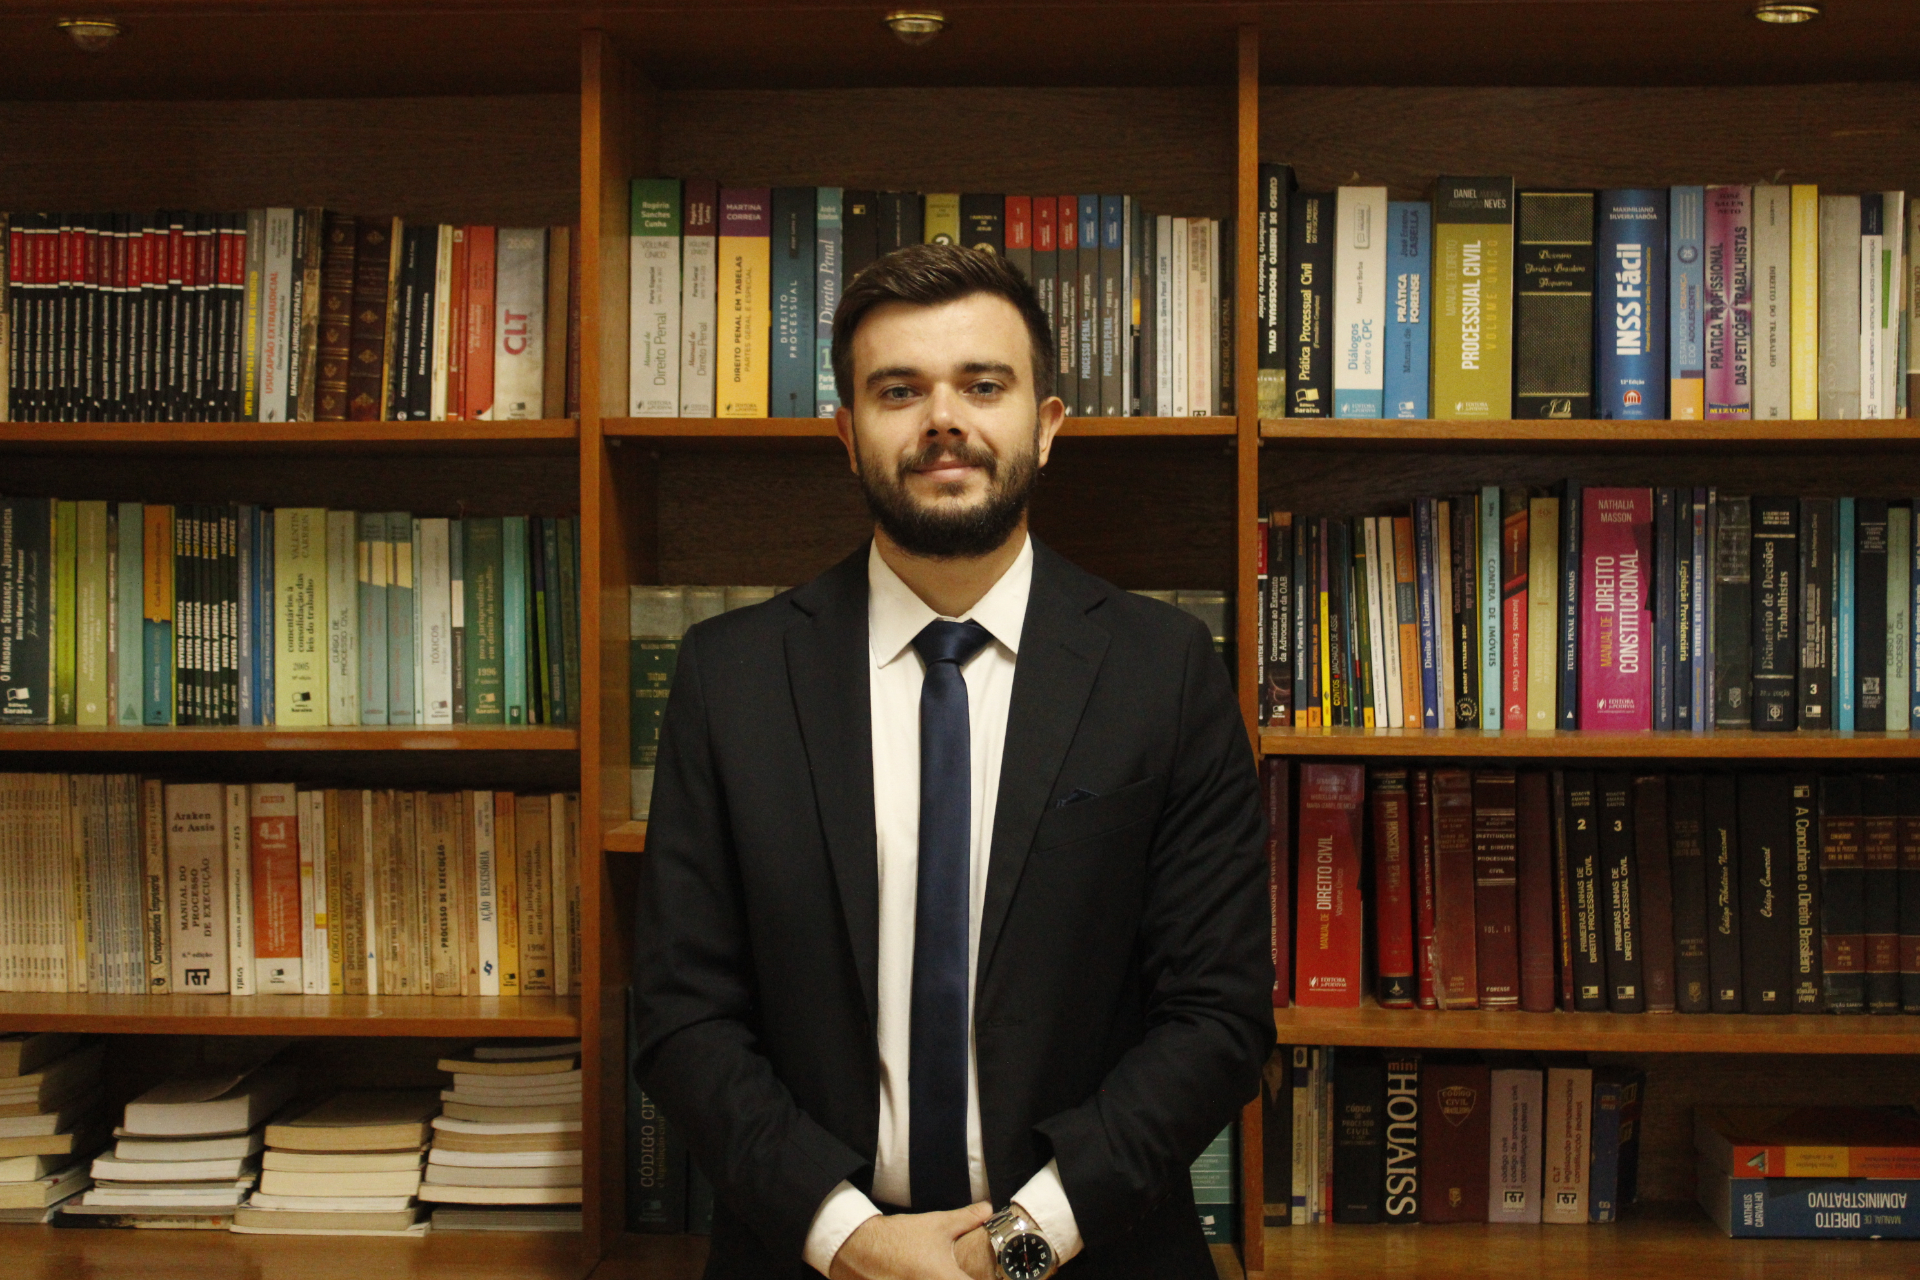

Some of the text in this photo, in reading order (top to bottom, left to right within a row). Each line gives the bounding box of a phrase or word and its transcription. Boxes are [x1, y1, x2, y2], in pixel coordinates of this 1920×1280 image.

[1270, 177, 1278, 208] CURSO
[1453, 189, 1476, 198] DANIEL
[1484, 200, 1506, 208] NEVES
[1270, 212, 1278, 224] DE
[1410, 210, 1419, 257] CASELLA
[735, 298, 742, 311] EM
[819, 240, 835, 325] Direito Penal
[1269, 268, 1277, 326] PROCESSUAL
[1395, 274, 1407, 322] PRÁTICA
[1410, 274, 1420, 323] FORENSE
[1462, 240, 1481, 370] PROCESSUAL CIVIL
[1484, 240, 1498, 350] VOLUME ÚNICO
[1615, 244, 1641, 355] INSS Fácil
[780, 294, 788, 343] DIREITO
[1299, 263, 1313, 380] Prática Processual Civil
[1680, 311, 1687, 323] DA
[1708, 243, 1723, 369] PRÁTICA PROFISSIONAL
[1732, 227, 1749, 385] DAS PETIÇÕES TRABALHISTAS
[264, 272, 278, 394] USUCAPIÃO EXTRAJUDICIAL
[419, 292, 429, 375] Direito Previdenciário
[503, 309, 527, 355] CLT
[644, 332, 650, 342] de
[654, 312, 666, 385] Direito Penal
[1082, 319, 1091, 378] PROCESSO PENAL
[1104, 317, 1112, 376] PROCESSO PENAL
[1268, 330, 1276, 354] CIVIL
[1348, 324, 1359, 370] Diálogos
[1362, 319, 1372, 340] CPC
[1688, 345, 1695, 358] DO
[1363, 350, 1371, 374] sobre
[1598, 500, 1634, 509] NATHALIA
[1600, 513, 1632, 523] MASSON
[1280, 576, 1288, 594] OAB
[1280, 595, 1287, 604] da
[1422, 589, 1430, 626] Literatura
[1762, 542, 1774, 669] Dicionário de Decisões
[1777, 571, 1788, 641] Trabalhistas
[285, 594, 294, 652] comentários
[295, 573, 306, 652] consolidação das
[305, 579, 314, 652] leis do trabalho
[1270, 576, 1278, 662] Comentários ao Estatuto
[1279, 613, 1287, 651] Advocacia
[1330, 615, 1338, 632] ASSIS
[1488, 558, 1498, 667] COMPRA DE IMÓVEIS
[1568, 605, 1574, 615] DE
[1596, 556, 1614, 667] MANUAL DE DIREITO
[1619, 550, 1638, 673] CONSTITUCIONAL
[1680, 560, 1689, 661] Legislação Previdenciária
[1280, 652, 1287, 662] da
[1331, 633, 1338, 641] DE
[1331, 643, 1340, 674] MACHADO
[1424, 640, 1432, 668] Direito
[1577, 819, 1586, 830] 2
[1795, 807, 1808, 816] A
[1317, 835, 1333, 863] CIVIL
[1795, 819, 1810, 871] Concubina
[179, 866, 188, 930] MANUAL DO
[191, 869, 199, 927] PROCESSO
[201, 858, 212, 937] DE EXECUÇÃO
[439, 893, 447, 902] DE
[478, 850, 493, 922] AÇÃO RESCISÓRIA
[1316, 866, 1332, 910] DIREITO
[1718, 828, 1732, 934] Código Tributário Nacional
[1760, 846, 1774, 918] Código Comercial
[440, 906, 448, 948] PROCESSO
[1577, 867, 1587, 952] PRIMEIRAS LINHAS DE
[1585, 856, 1597, 963] DIREITO PROCESSUAL CIVIL
[1797, 893, 1812, 925] Direito
[1320, 924, 1329, 949] MANUAL
[1798, 928, 1814, 973] Brasileiro
[638, 1125, 655, 1187] CÓDIGO
[1385, 1072, 1417, 1215] HOUAISS
[1564, 1140, 1573, 1183] legislação
[1744, 1194, 1753, 1225] MATHEUS
[1754, 1192, 1764, 1227] CARVALHO
[1808, 1192, 1907, 1208] ADMINISTRATIVO
[1815, 1212, 1861, 1228] DIREITO
